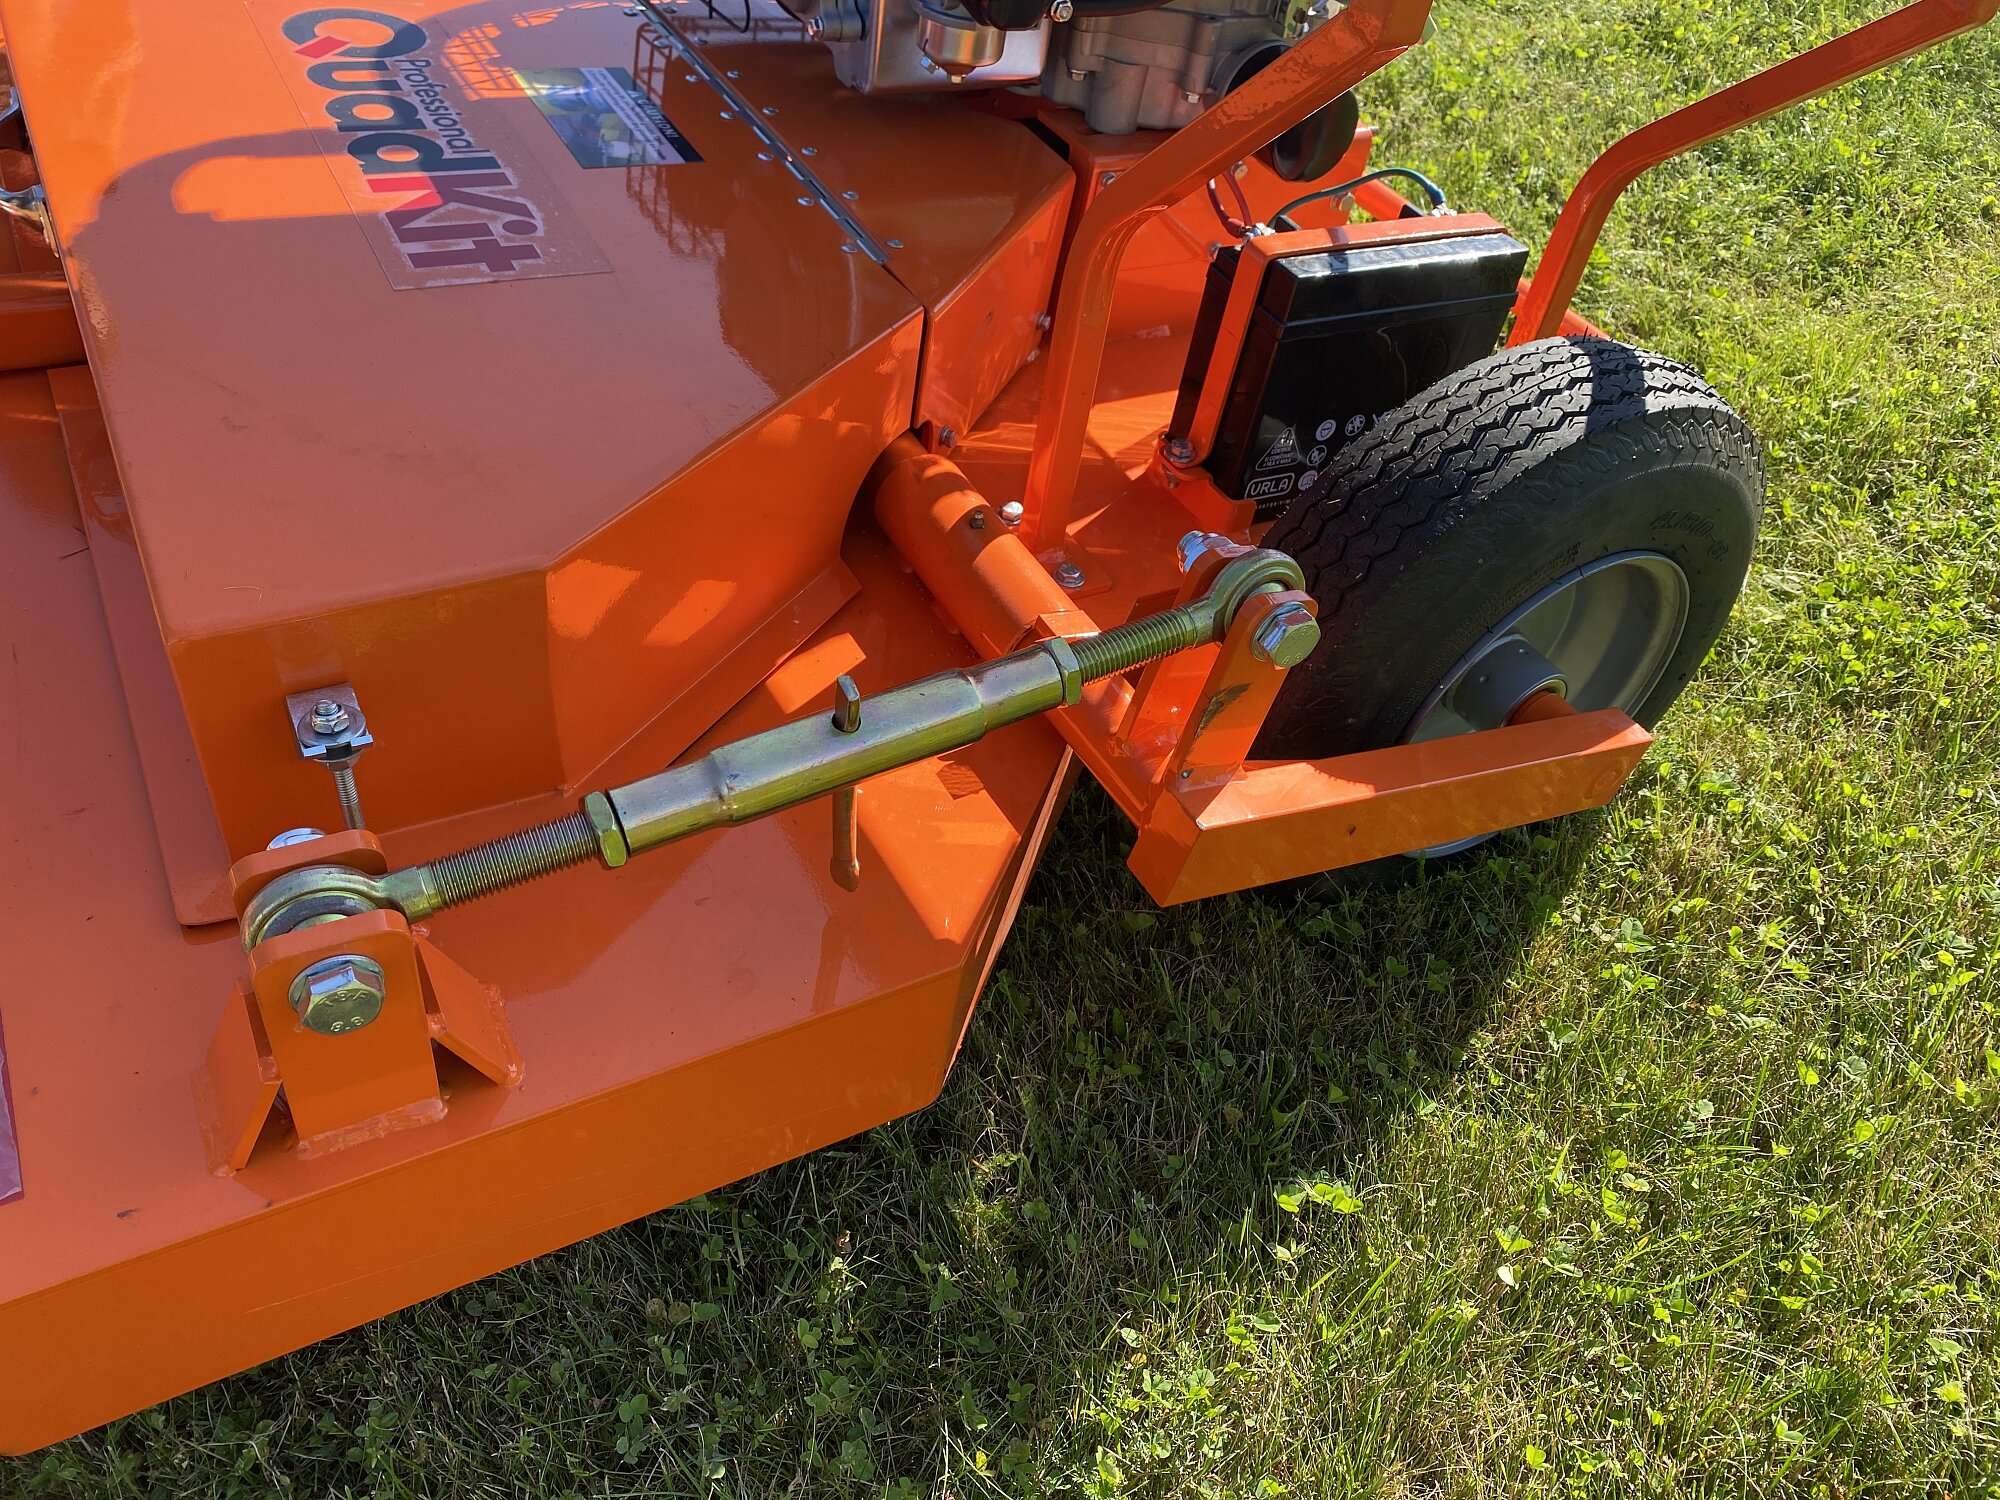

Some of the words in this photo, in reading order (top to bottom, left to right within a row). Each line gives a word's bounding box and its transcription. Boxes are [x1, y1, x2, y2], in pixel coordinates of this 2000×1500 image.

[281, 8, 542, 273] QuadKit
[394, 59, 491, 154] Professional
[637, 98, 680, 138] CAUTION!
